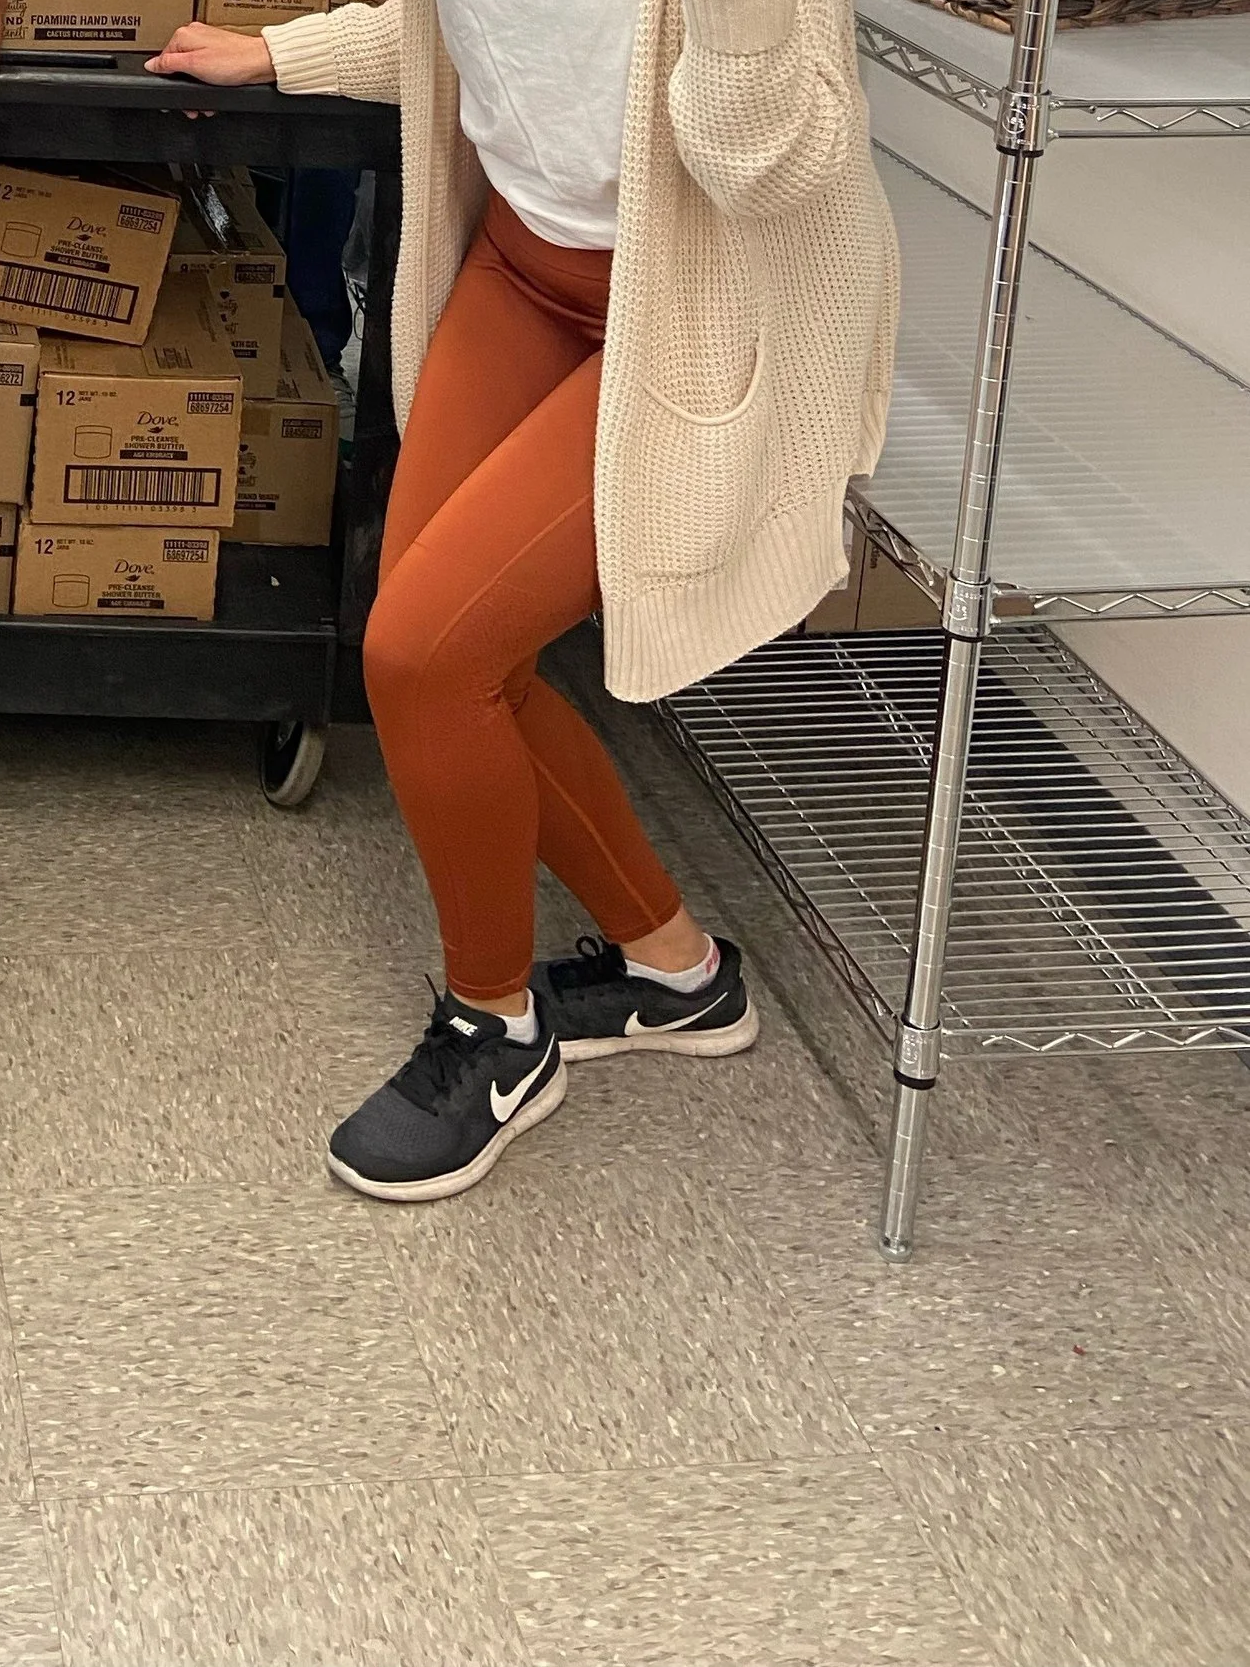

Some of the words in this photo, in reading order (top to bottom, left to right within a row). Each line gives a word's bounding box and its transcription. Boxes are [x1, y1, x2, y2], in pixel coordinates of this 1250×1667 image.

[6, 16, 24, 25] ND
[31, 15, 77, 25] FOAMING
[80, 16, 108, 26] HAND
[111, 16, 141, 26] WASH
[66, 216, 107, 235] Dove
[50, 245, 81, 257] SHOWER
[80, 249, 110, 262] BUTTER
[57, 238, 106, 254] PRE-CLEANSE
[56, 390, 77, 406] 12
[190, 402, 229, 413] 68697254
[136, 411, 177, 426] Dove
[124, 442, 155, 450] SHOWER
[156, 443, 185, 451] BUTTER
[130, 435, 179, 444] PRE-CLEANSE
[35, 539, 54, 555] 12
[114, 559, 155, 575] Dove
[108, 584, 155, 592] PRE-CLEANSE
[133, 591, 161, 599] BUTTER
[449, 1016, 478, 1037] NIKE
